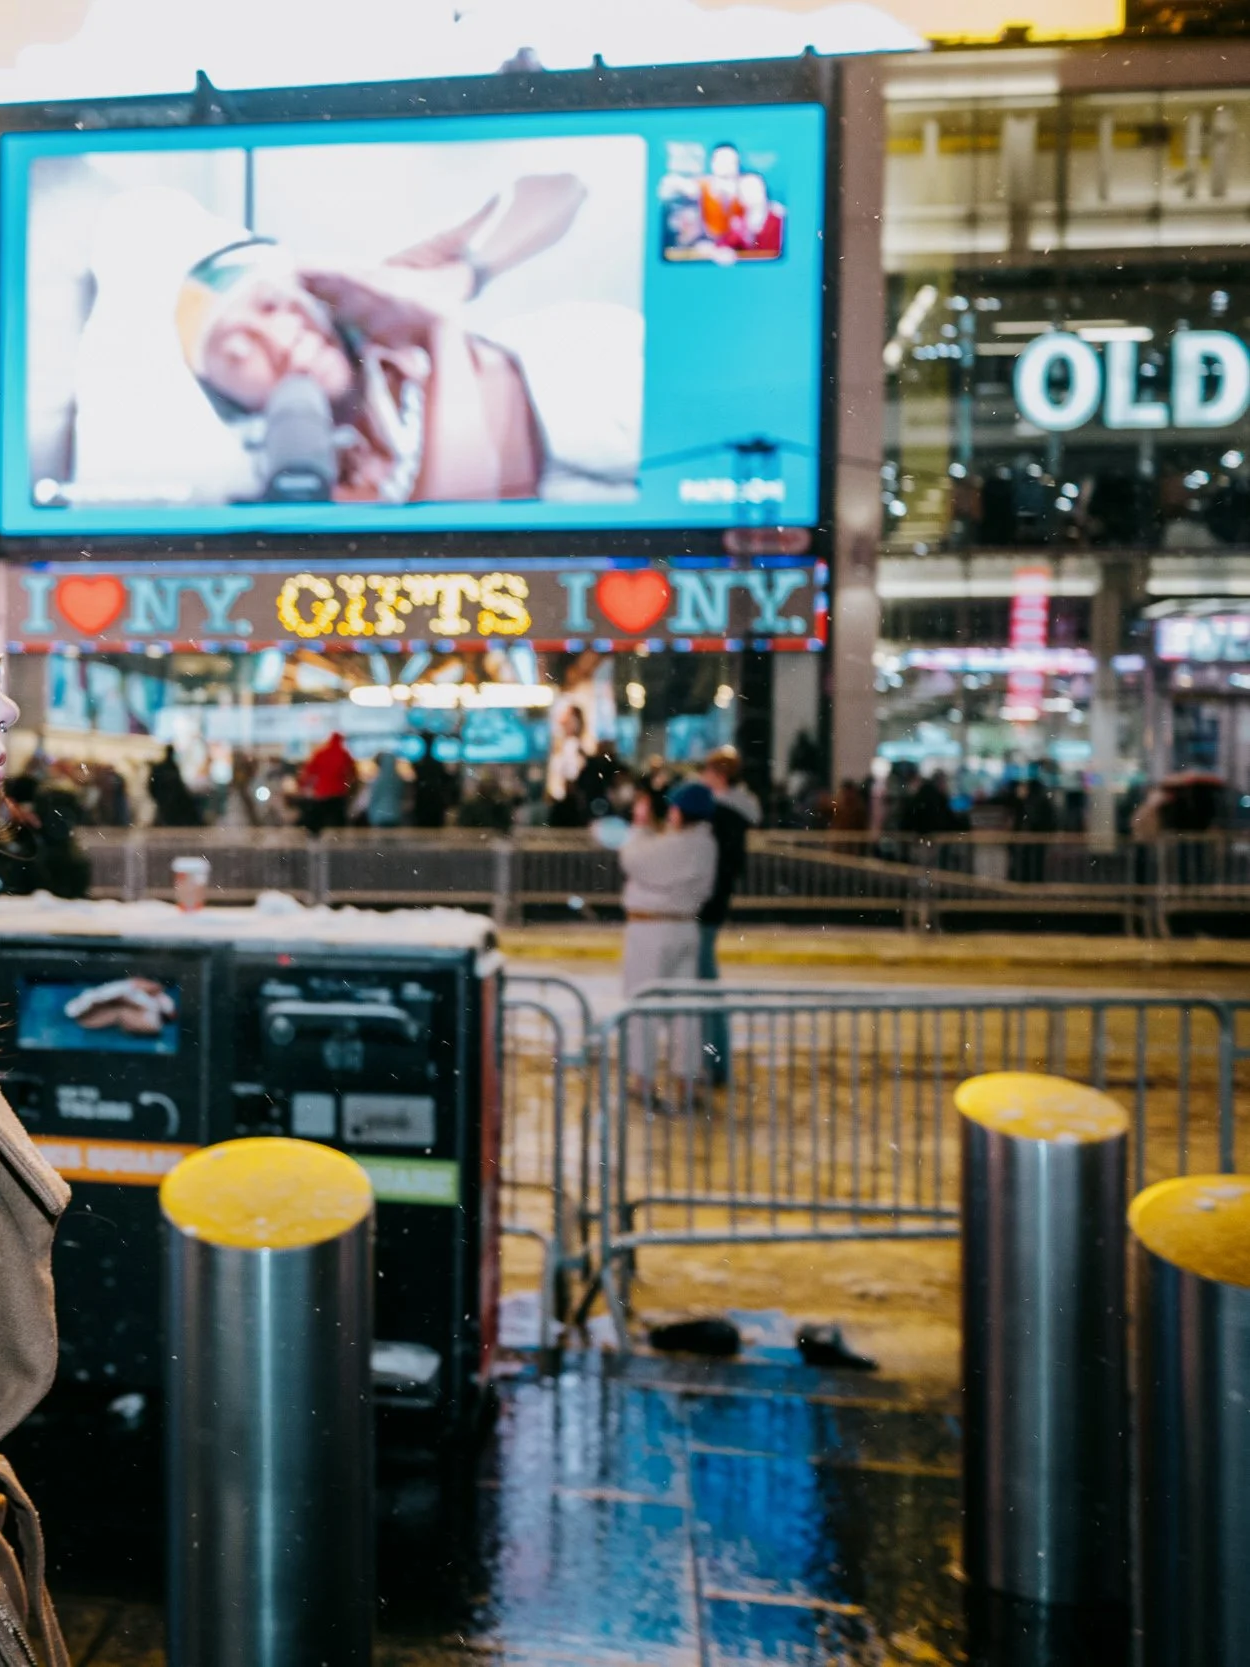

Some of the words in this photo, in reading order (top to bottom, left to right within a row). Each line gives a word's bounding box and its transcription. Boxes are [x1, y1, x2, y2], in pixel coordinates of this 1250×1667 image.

[1014, 331, 1250, 432] OLD
[20, 575, 59, 634] I
[123, 575, 253, 636] NY.
[276, 572, 532, 638] GIFTS
[557, 571, 597, 632] I
[667, 570, 808, 634] NY.
